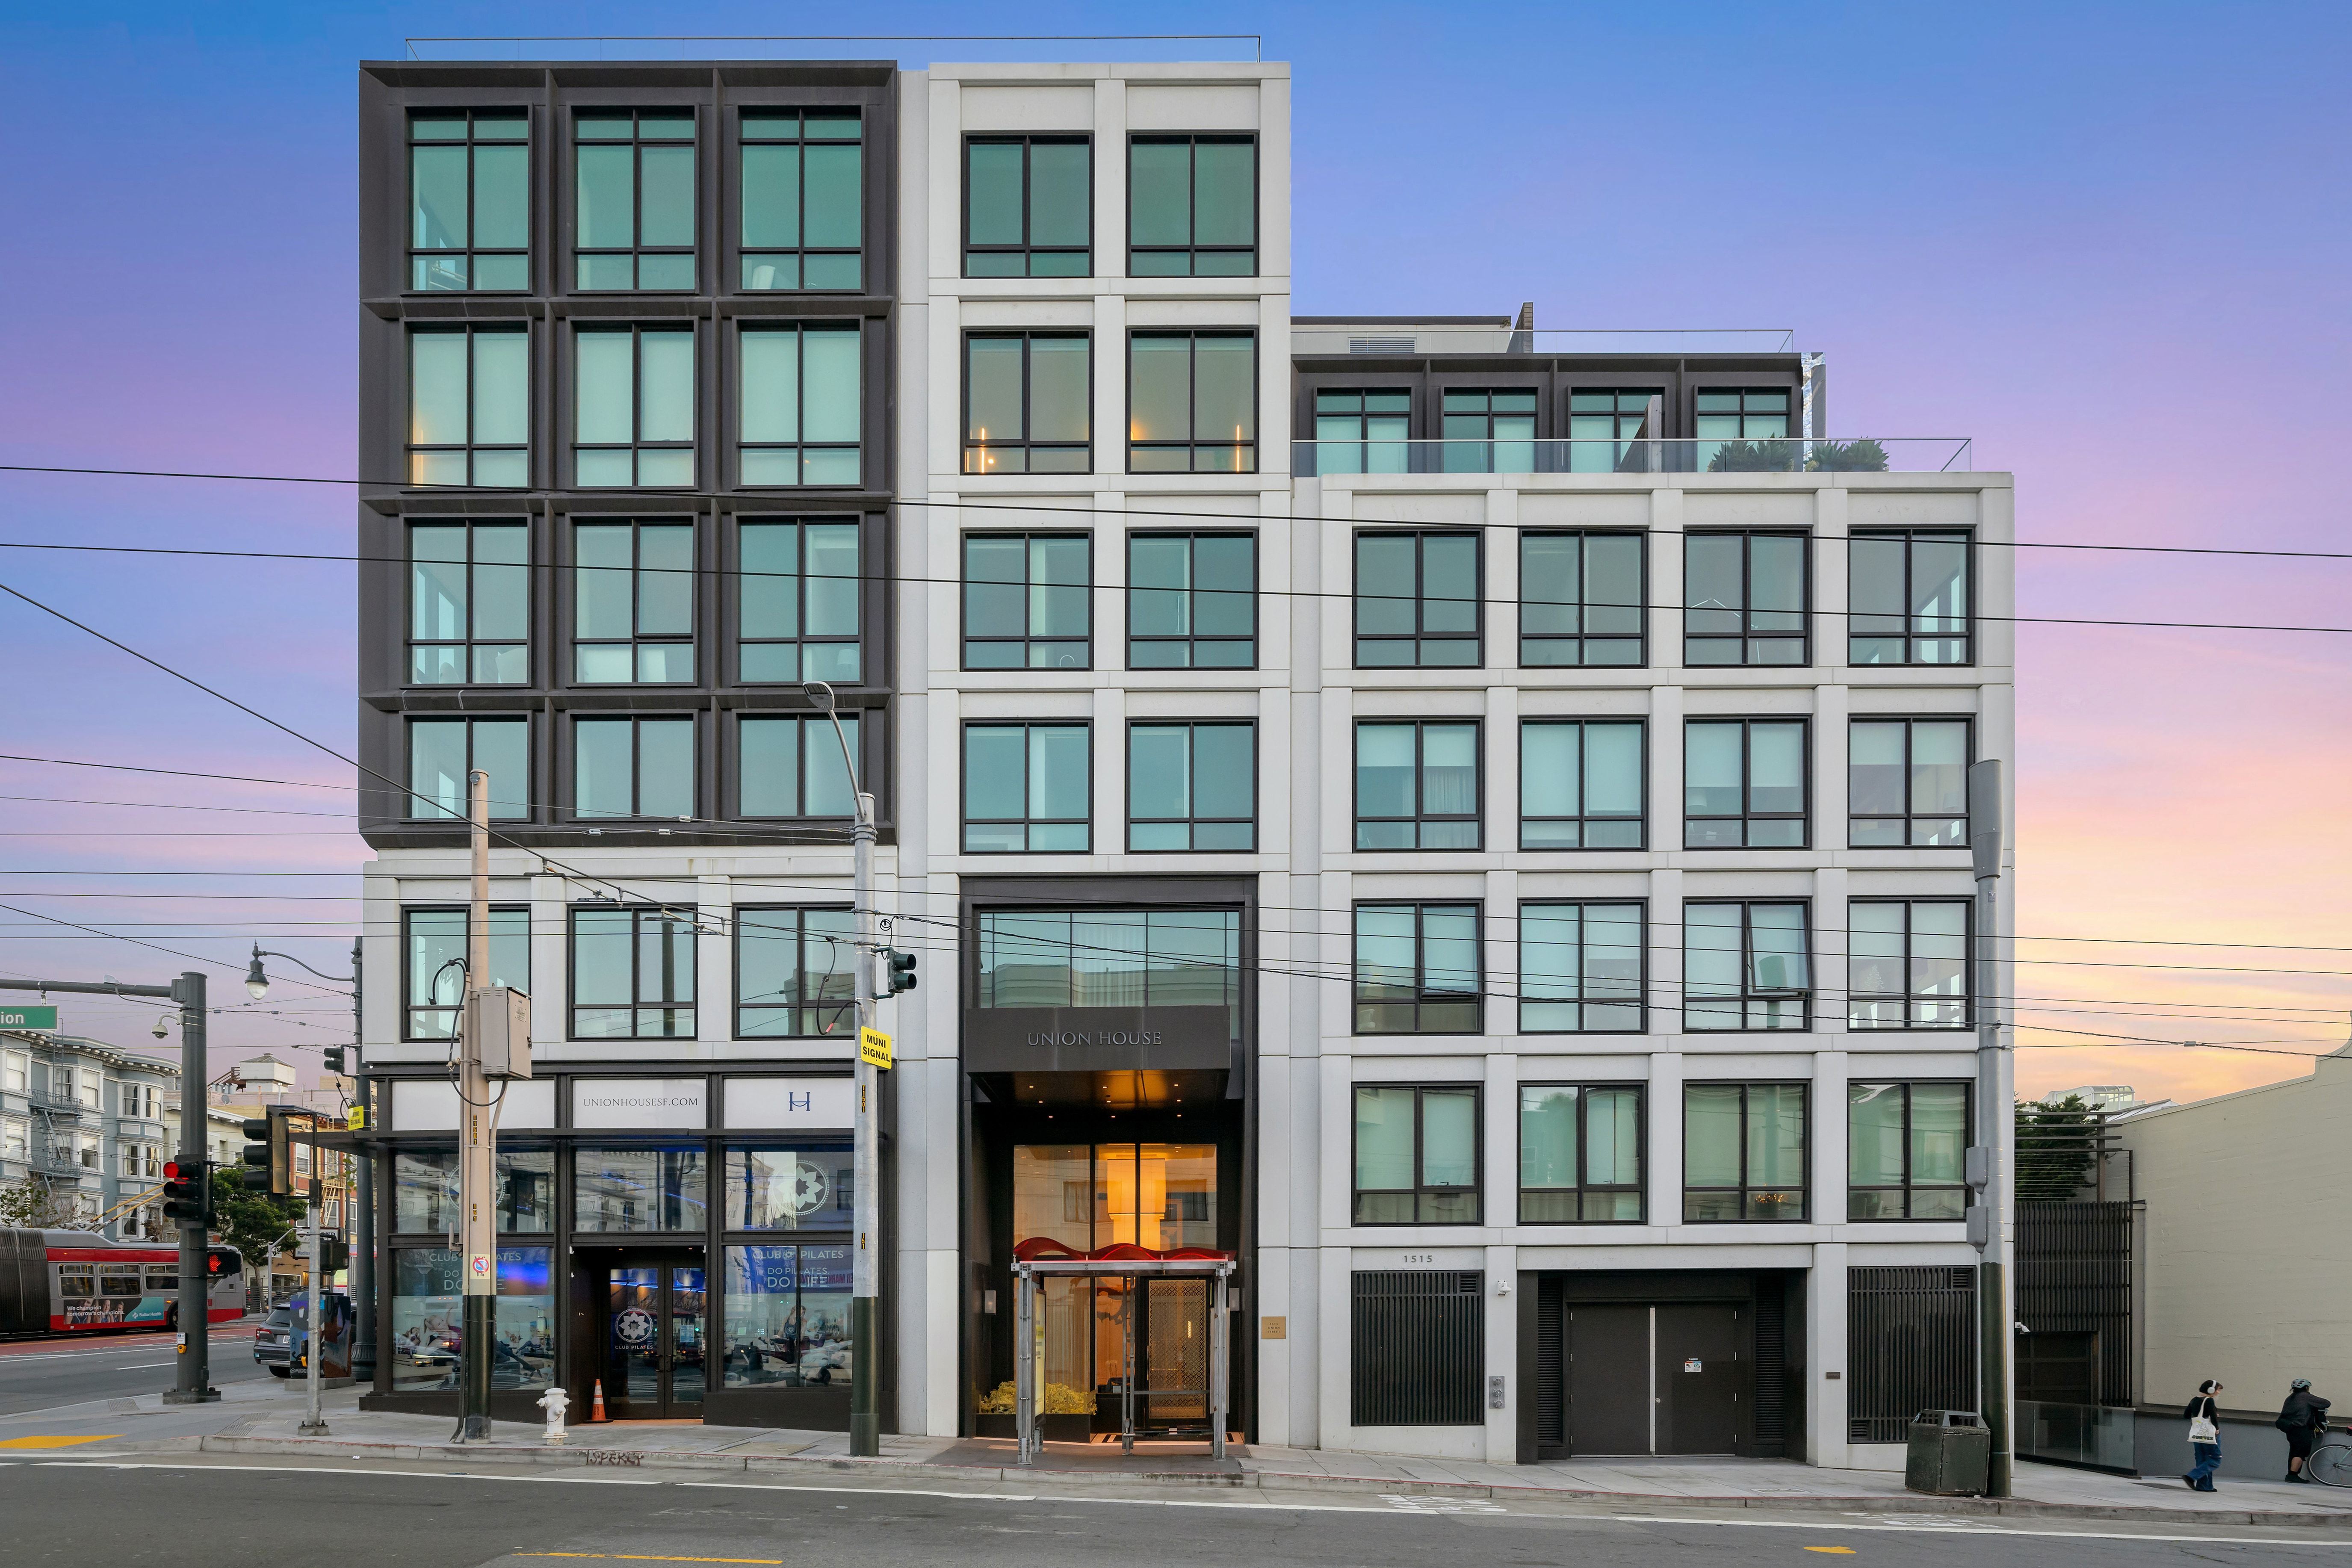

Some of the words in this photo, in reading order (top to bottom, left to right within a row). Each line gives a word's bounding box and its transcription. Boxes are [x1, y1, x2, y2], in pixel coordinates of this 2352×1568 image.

[0, 1011, 24, 1024] ion
[866, 1034, 886, 1048] MUNI
[1028, 1031, 1091, 1046] UNION
[1099, 1031, 1162, 1045] HOUSE
[863, 1046, 890, 1062] SIGNAL
[583, 1097, 698, 1107] UNIONHOUSESF.COM
[429, 1253, 458, 1262] CLUB
[753, 1250, 782, 1259] CLUB
[801, 1250, 844, 1259] PILATES
[768, 1277, 791, 1288] DO
